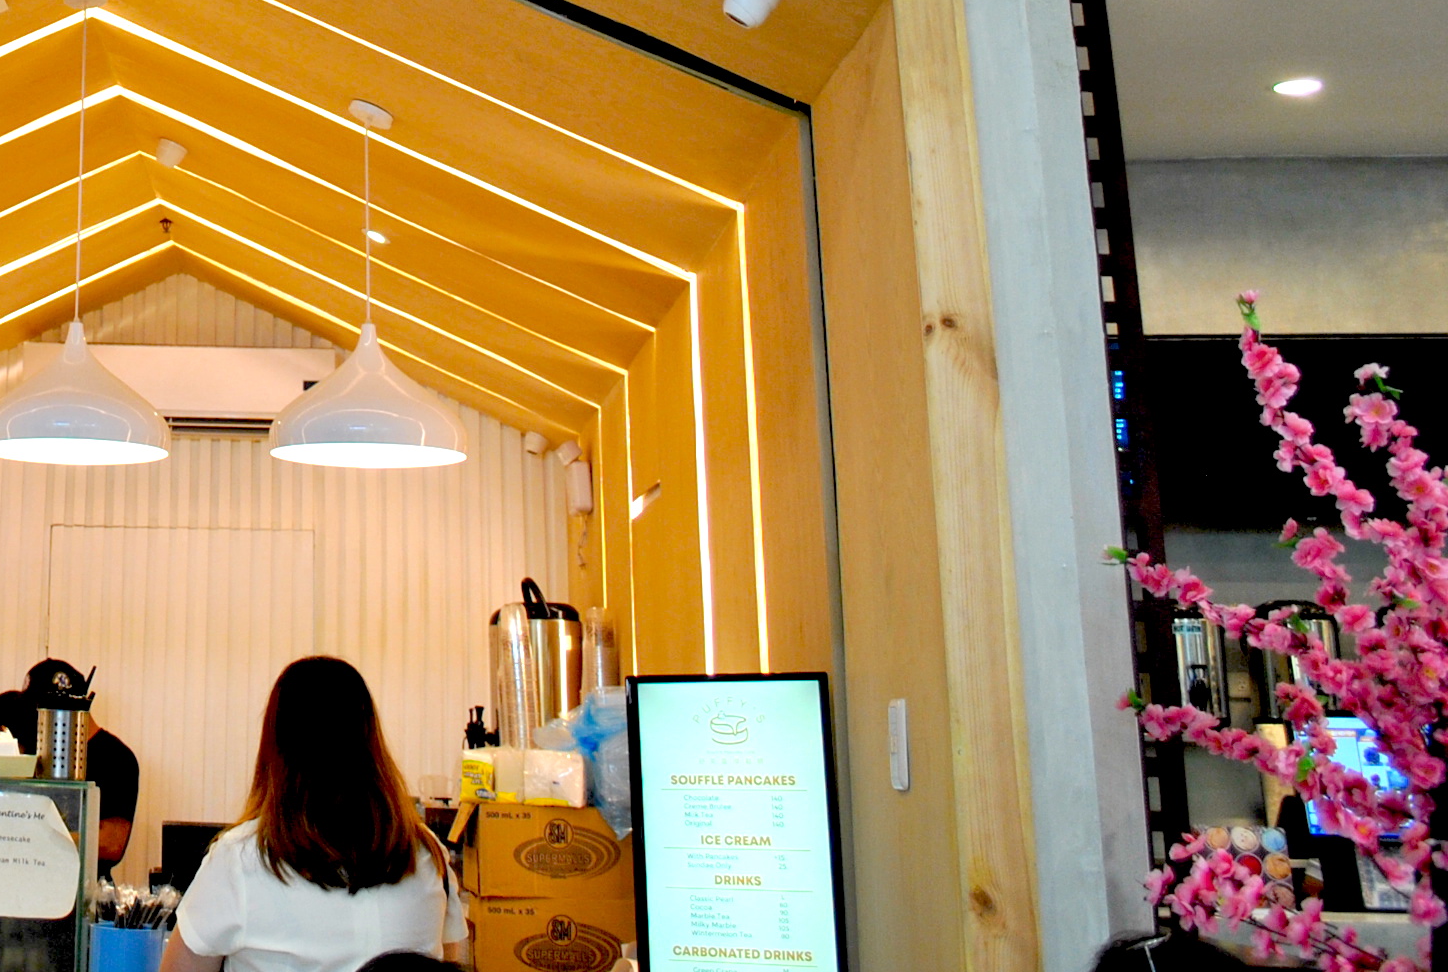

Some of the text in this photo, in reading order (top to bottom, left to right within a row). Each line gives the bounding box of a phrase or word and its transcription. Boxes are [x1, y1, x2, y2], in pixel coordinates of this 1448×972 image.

[727, 775, 796, 786] PANCAKES
[700, 835, 771, 846] ICE CREAM
[714, 875, 762, 886] DRINKS
[672, 945, 813, 962] CARBONATED DRINKS
